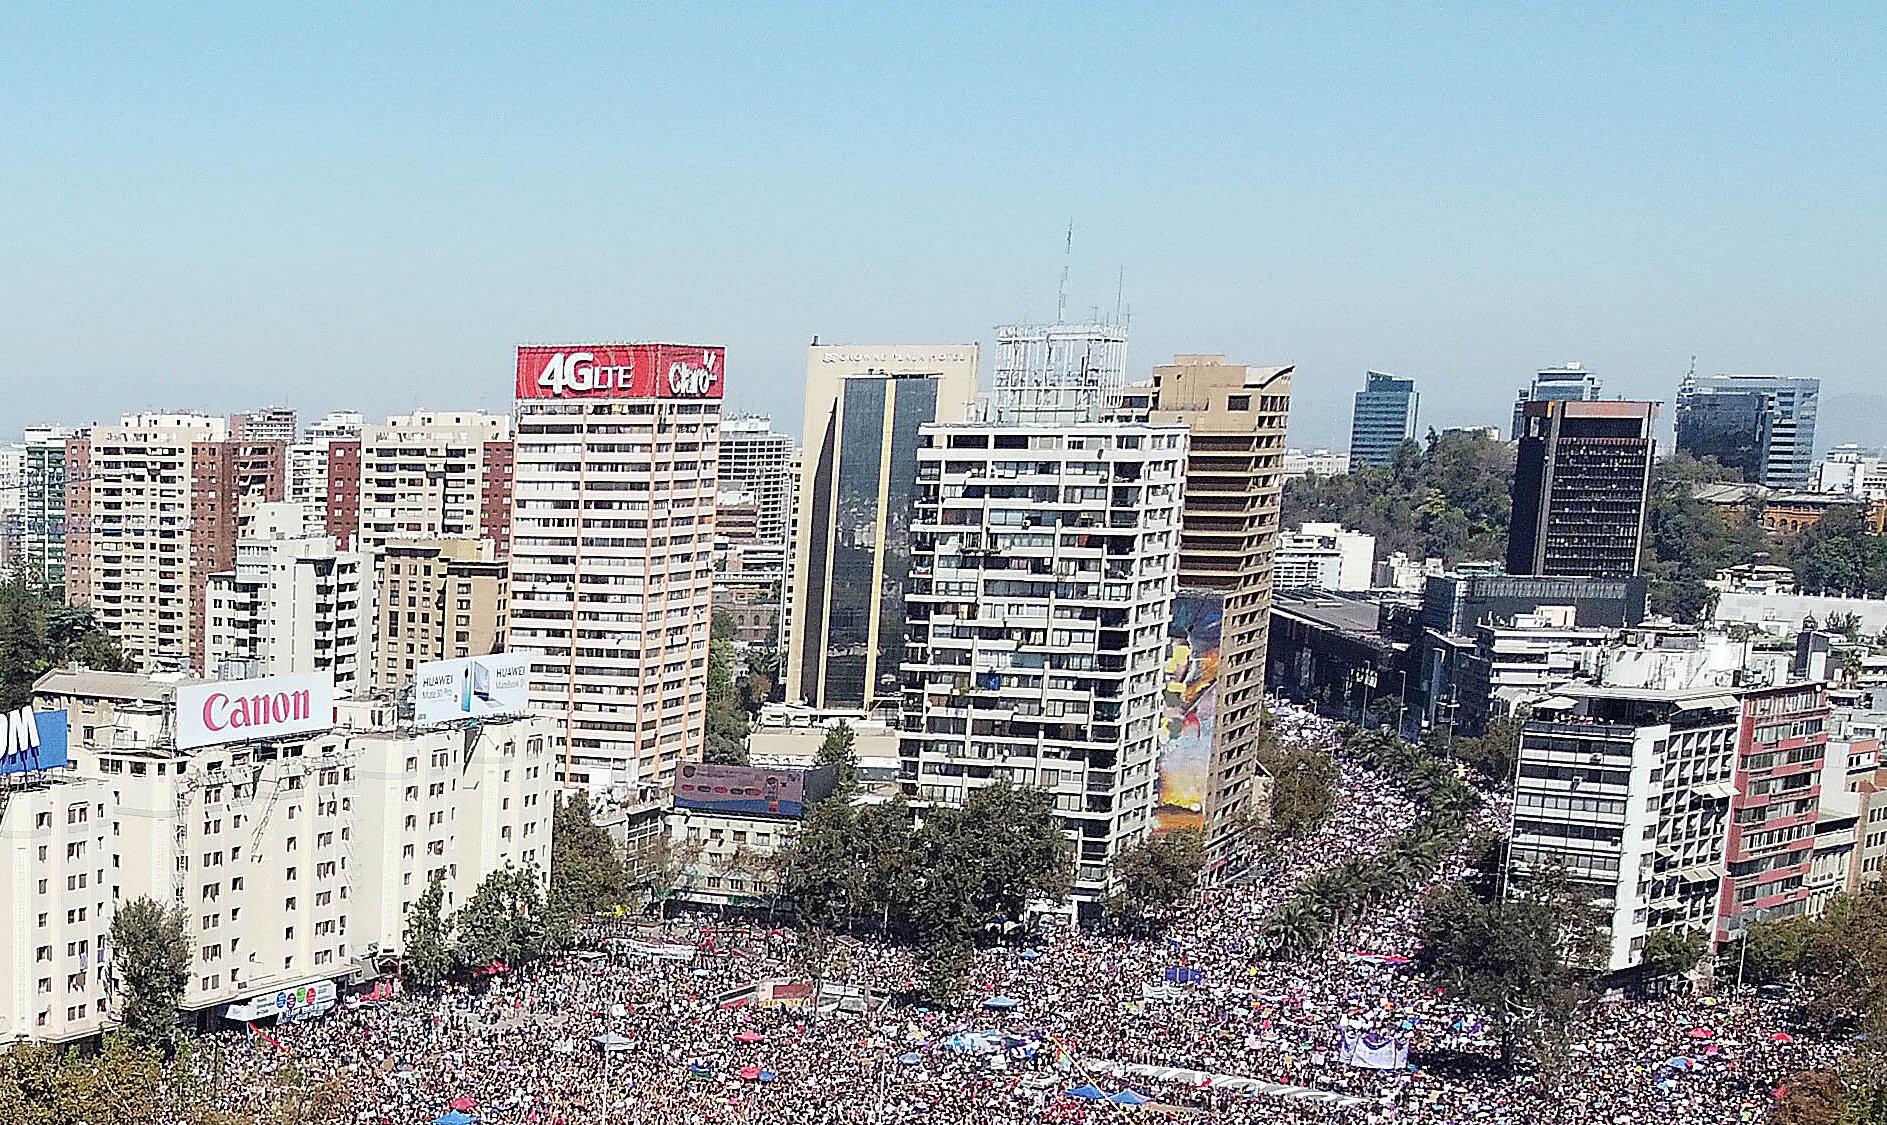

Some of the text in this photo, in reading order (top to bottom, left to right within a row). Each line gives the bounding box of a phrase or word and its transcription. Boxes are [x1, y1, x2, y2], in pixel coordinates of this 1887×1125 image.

[669, 358, 713, 395] Claro
[423, 674, 454, 687] HUAWEI
[496, 665, 526, 678] HUAWEI
[203, 689, 310, 732] Canon
